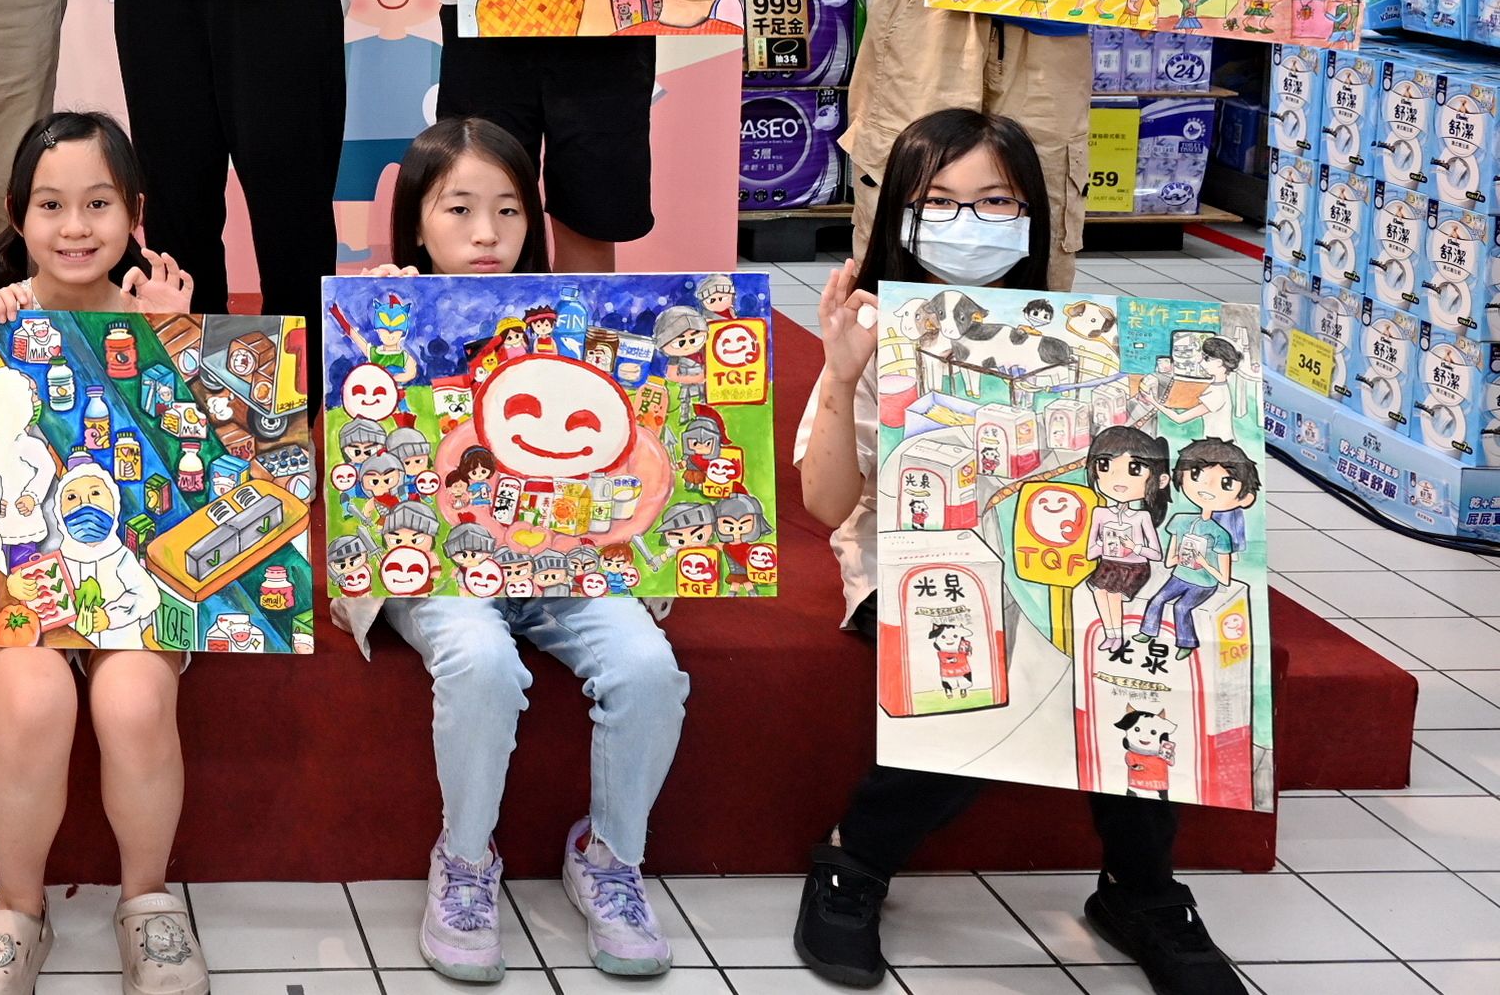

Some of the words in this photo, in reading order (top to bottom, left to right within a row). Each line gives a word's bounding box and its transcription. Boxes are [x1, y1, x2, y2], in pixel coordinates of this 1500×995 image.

[752, 17, 805, 36] 千足金
[1173, 64, 1196, 79] 24
[1395, 104, 1417, 124] 舒潔
[741, 117, 800, 140] ASEO
[1449, 119, 1475, 140] 舒潔
[1386, 222, 1411, 244] 舒潔
[1440, 243, 1467, 266] 舒潔
[556, 313, 586, 330] FIN
[29, 347, 49, 359] Milk
[1373, 340, 1398, 364] 舒潔
[1297, 352, 1321, 377] 345
[712, 369, 759, 387] TQF
[1432, 365, 1461, 391] 舒潔
[182, 424, 202, 437] Milk
[180, 474, 203, 488] Milk
[905, 472, 931, 489] 光泉
[1335, 457, 1398, 501] 屁屁更舒服
[703, 484, 731, 497] TQF
[1016, 544, 1086, 577] TQF
[749, 570, 777, 584] TQF
[679, 581, 714, 596] TQF
[913, 573, 966, 603] 光泉
[261, 592, 284, 607] small
[1219, 642, 1250, 667] TQF
